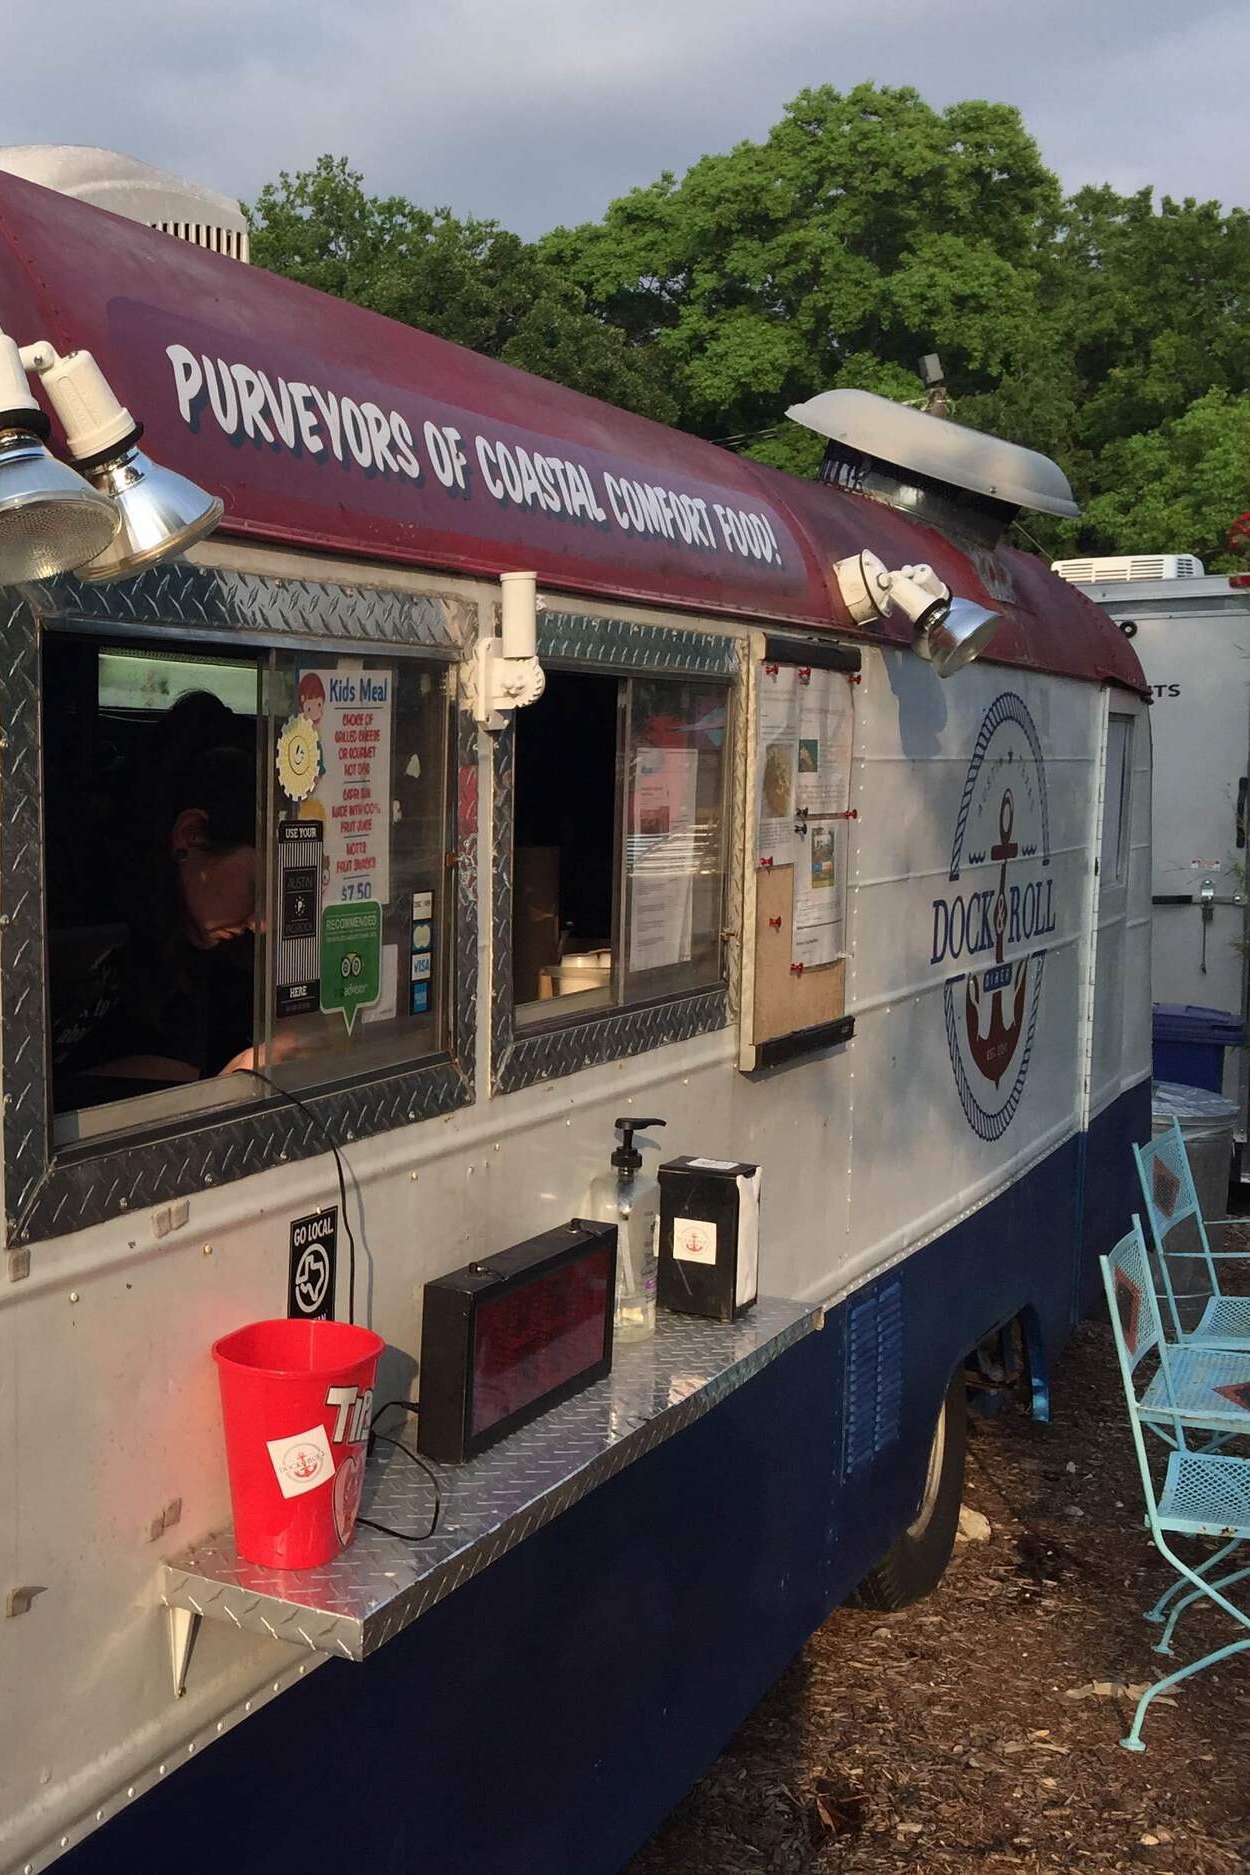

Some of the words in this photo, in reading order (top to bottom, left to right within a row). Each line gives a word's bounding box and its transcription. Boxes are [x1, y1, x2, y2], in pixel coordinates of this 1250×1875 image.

[166, 344, 420, 478] PURVEYORS
[423, 420, 467, 489] OF
[475, 435, 607, 522] COASTAL
[603, 471, 717, 549] COMFORT
[713, 503, 783, 566] FOOD!
[329, 677, 356, 702] Kids
[359, 676, 388, 702] Meal
[1148, 684, 1181, 698] TS
[285, 828, 298, 839] USE
[299, 827, 317, 838] YOUR
[326, 915, 376, 930] RECOMMENDED
[930, 890, 995, 965] DOCK
[1008, 879, 1056, 943] ROLL
[413, 958, 430, 973] VISA
[289, 986, 308, 998] HERE
[294, 1226, 306, 1247] GO
[308, 1217, 334, 1242] LOCAL
